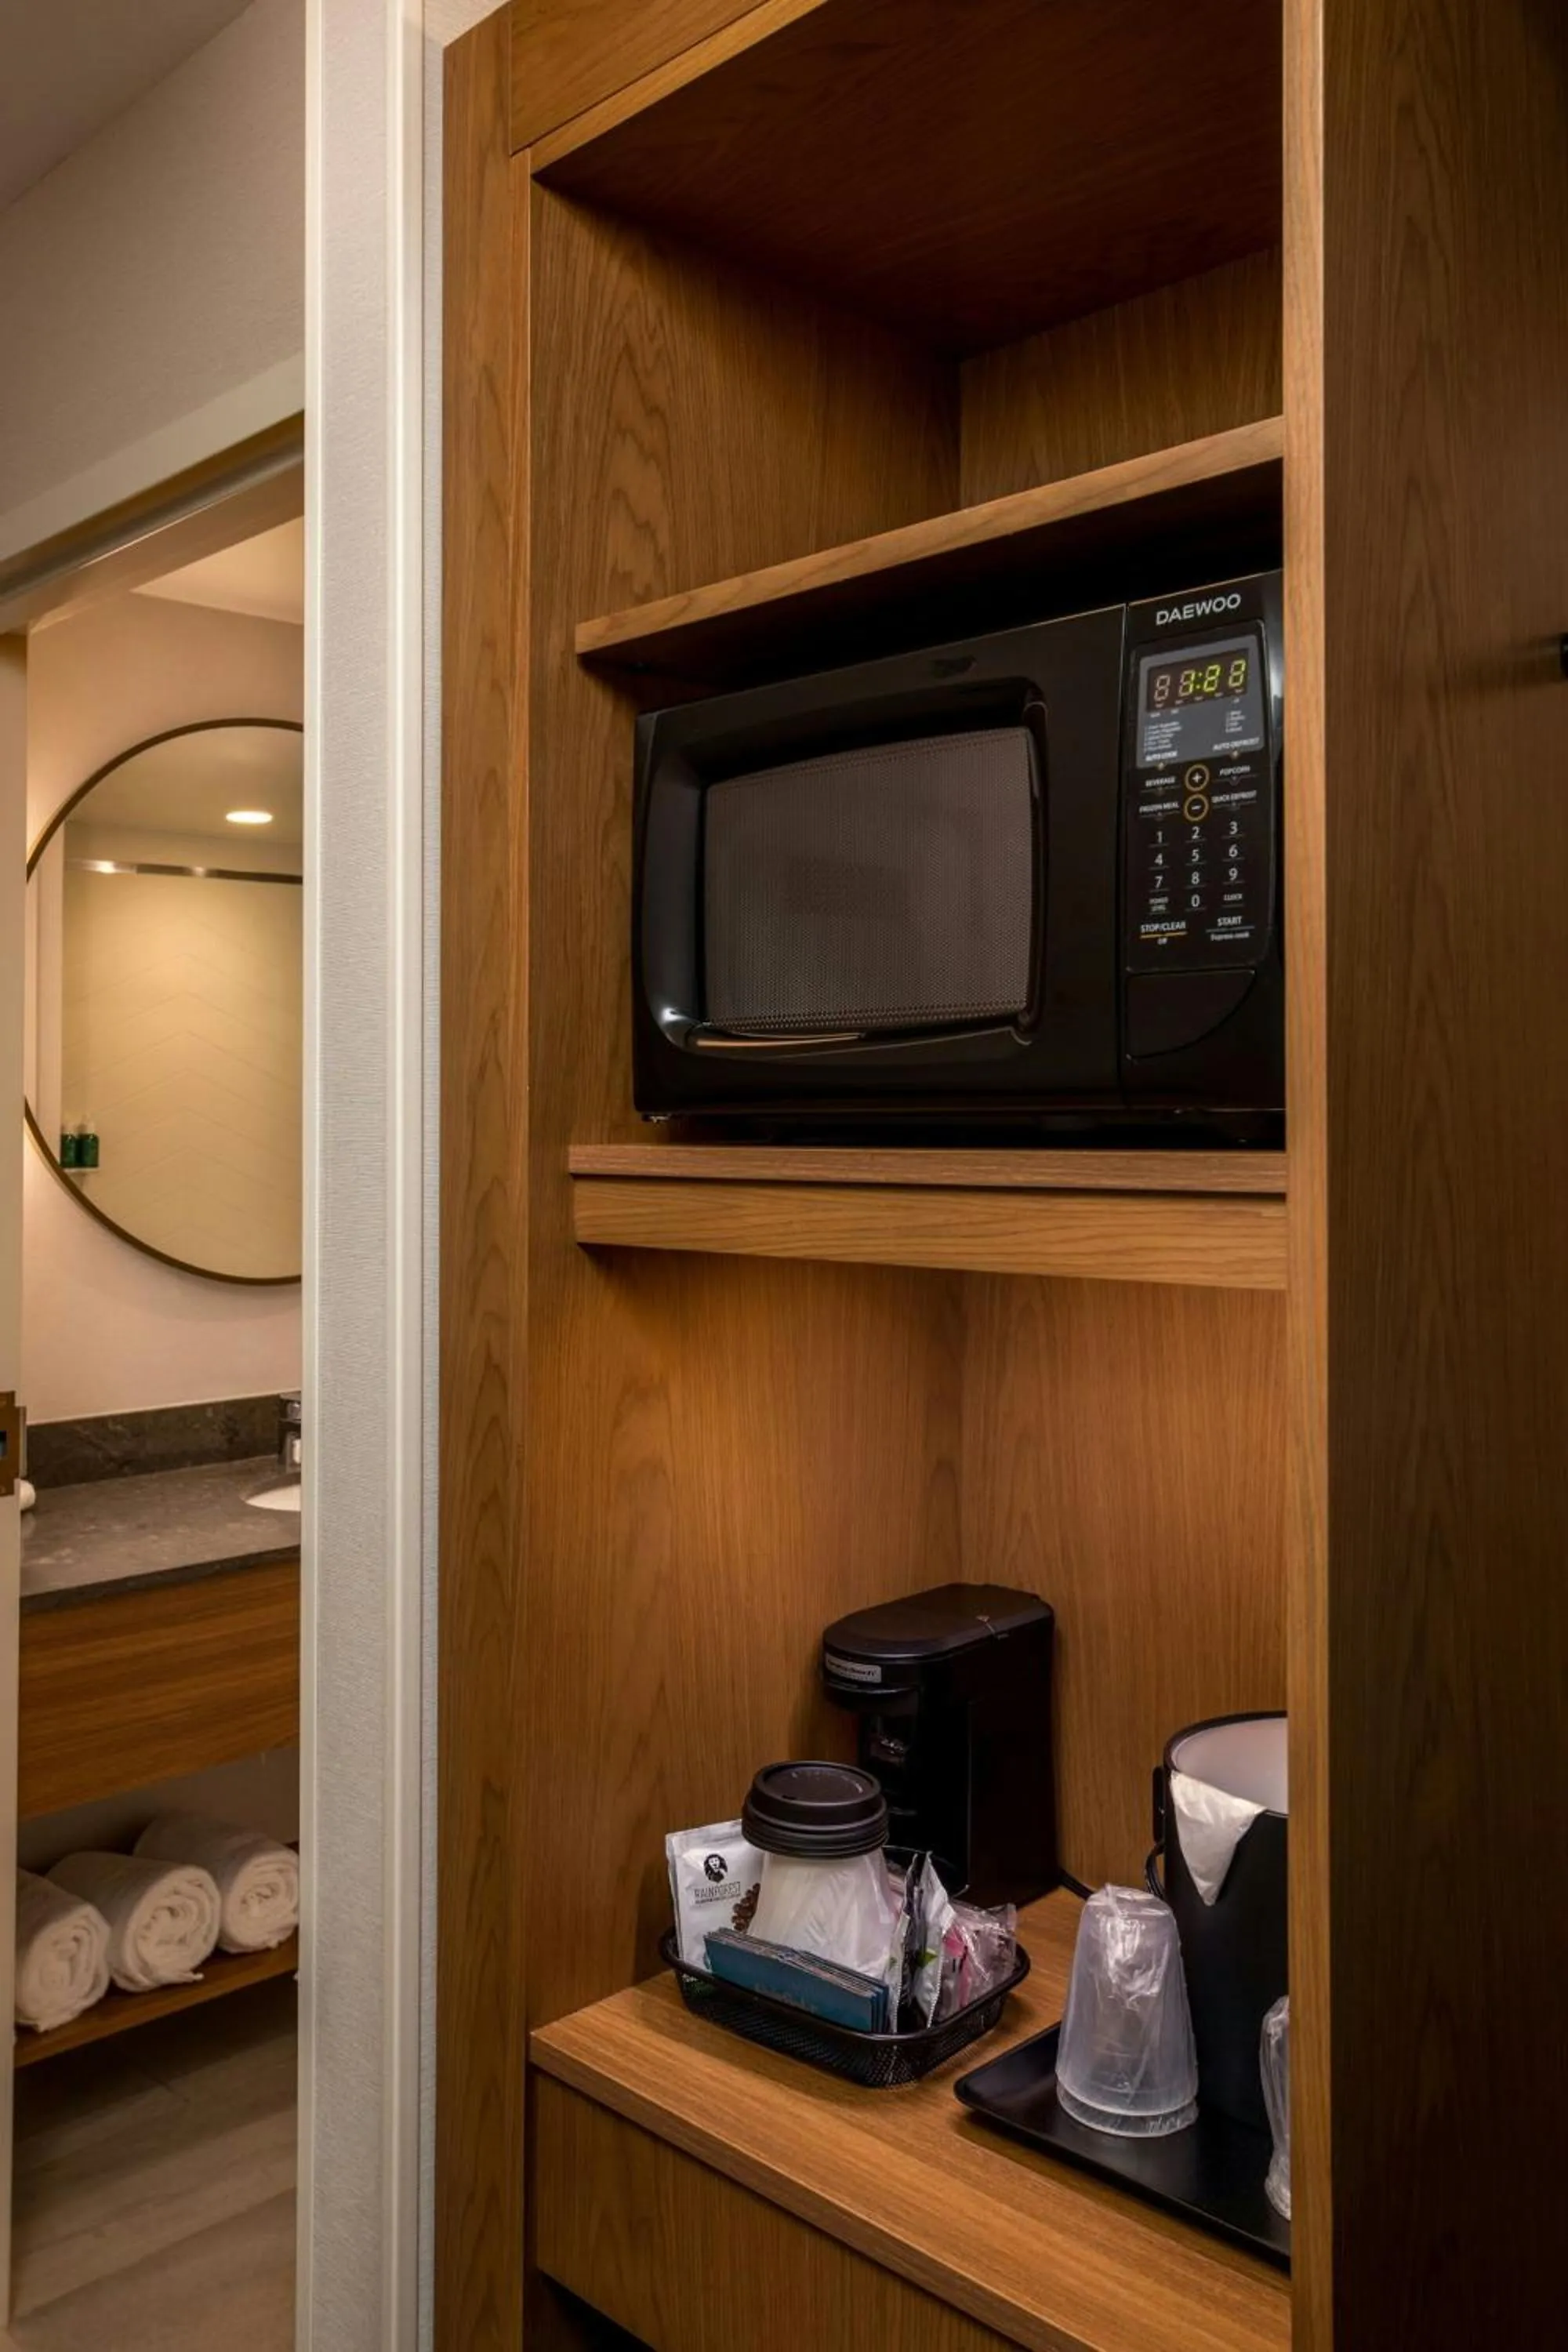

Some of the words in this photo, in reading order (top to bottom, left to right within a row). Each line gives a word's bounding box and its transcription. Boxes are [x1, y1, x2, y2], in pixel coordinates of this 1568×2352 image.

[1156, 593, 1242, 626] DAEWOO
[1219, 765, 1251, 776] POPCORN
[1145, 776, 1176, 787] BEVERAGE
[1192, 826, 1200, 840] 2
[1229, 821, 1238, 835] 3
[1192, 849, 1200, 862] 5
[1229, 844, 1238, 858] 6
[1154, 853, 1163, 866] 4
[1191, 872, 1200, 885] 8
[1229, 868, 1238, 881] 9
[1155, 876, 1163, 888] 7
[1191, 895, 1200, 908] 0
[1140, 920, 1186, 934] STOP/CLEAR
[1217, 916, 1242, 927] START
